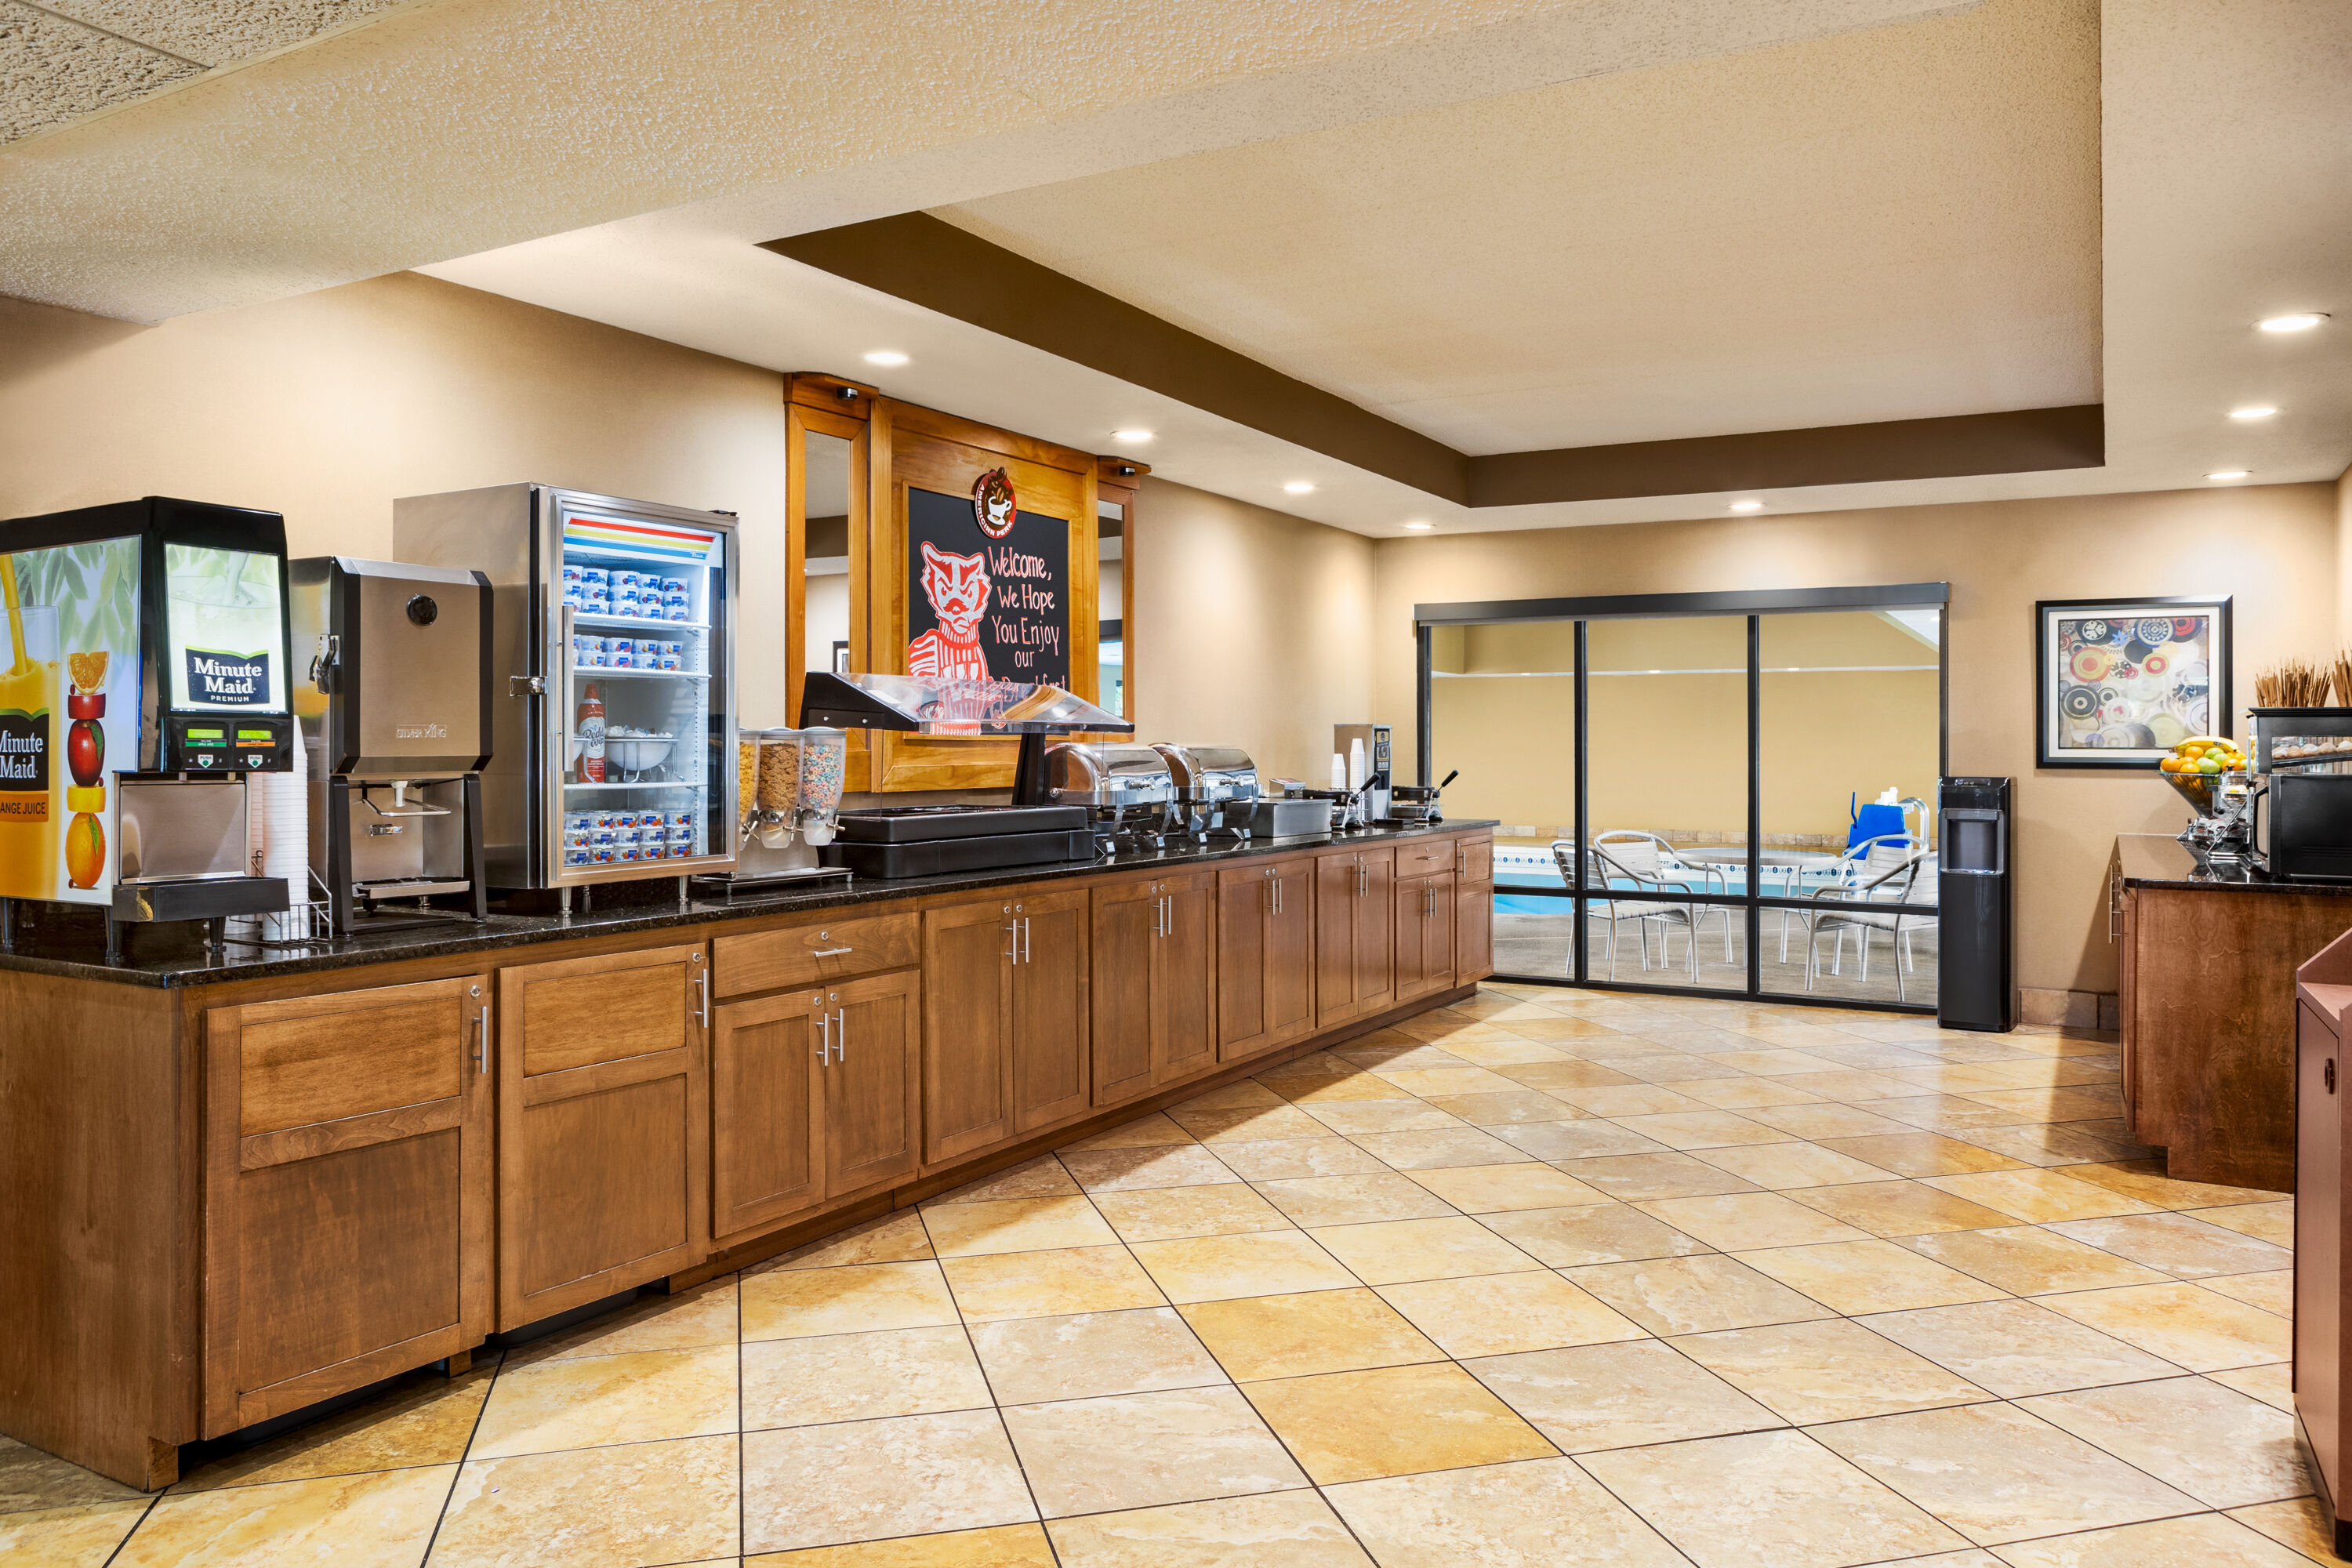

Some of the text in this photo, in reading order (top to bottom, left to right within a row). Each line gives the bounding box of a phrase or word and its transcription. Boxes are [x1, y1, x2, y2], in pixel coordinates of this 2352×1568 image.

[978, 483, 1013, 537] AMERICINN PERK
[987, 546, 1051, 581] Welcome,
[997, 583, 1055, 615] We Hope
[991, 615, 1059, 656] You Enjoy
[193, 656, 263, 677] Minute
[1014, 651, 1035, 668] our
[204, 675, 254, 695] Maid
[0, 755, 36, 779] Maid
[22, 802, 45, 815] JUICE
